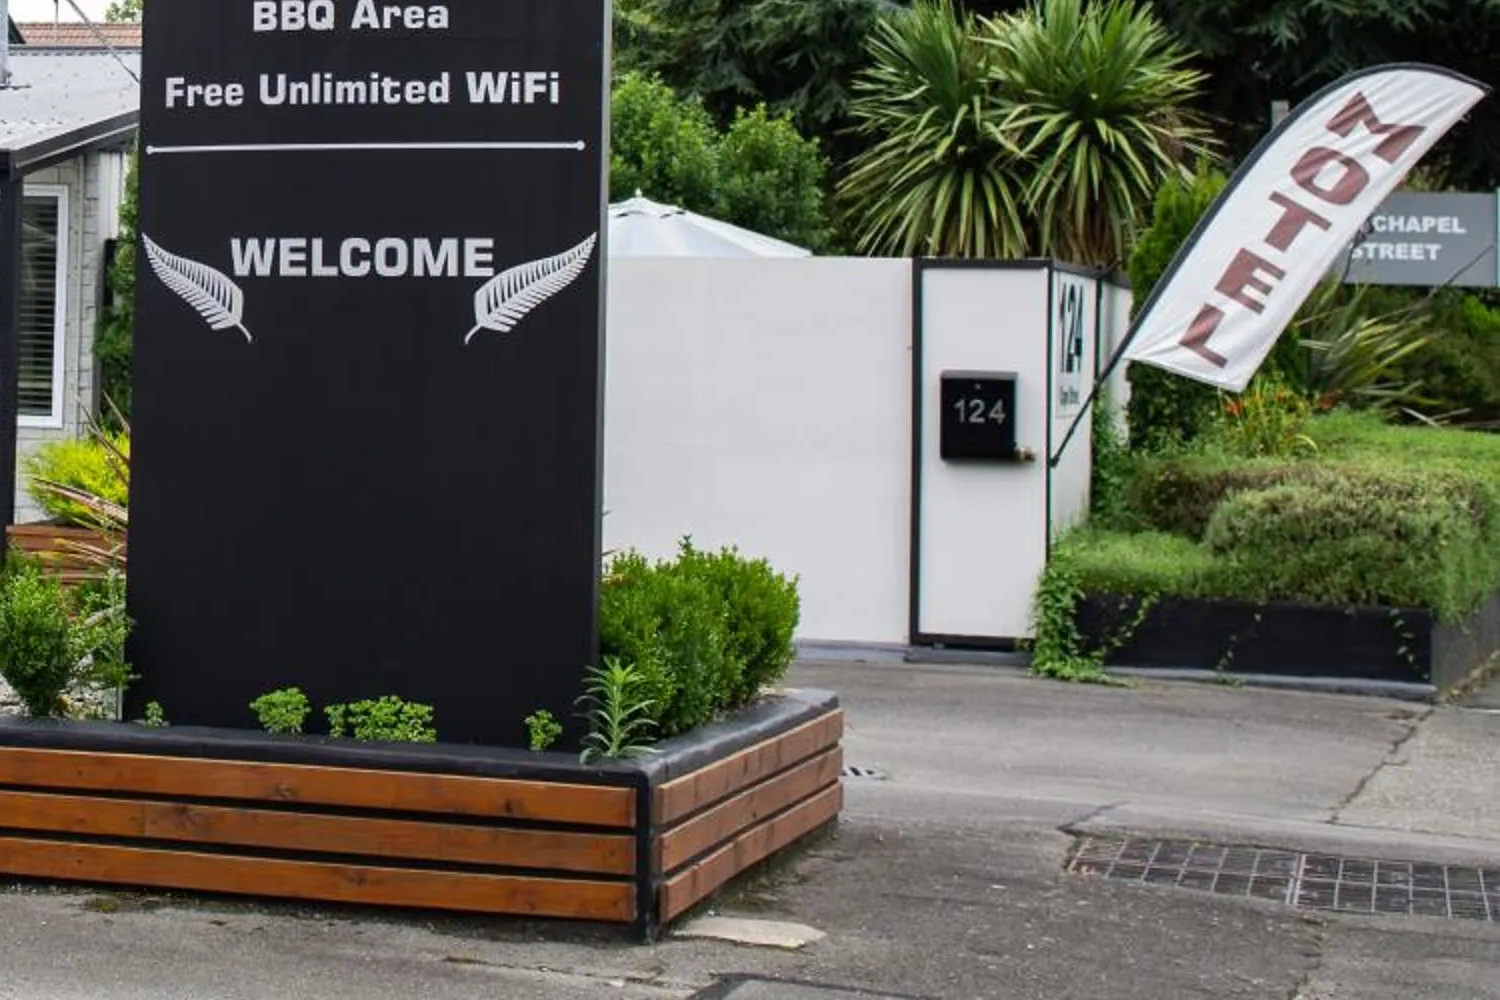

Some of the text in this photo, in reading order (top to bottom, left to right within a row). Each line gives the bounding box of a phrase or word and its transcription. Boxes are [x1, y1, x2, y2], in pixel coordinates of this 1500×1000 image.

[164, 71, 560, 108] Free Unlimited WiFi
[1178, 91, 1424, 368] MOTEL
[1371, 215, 1467, 234] CHAPEL
[230, 238, 495, 277] WELCOME
[1349, 242, 1442, 261] STREET
[1059, 282, 1084, 373] 124
[953, 399, 1006, 425] 124
